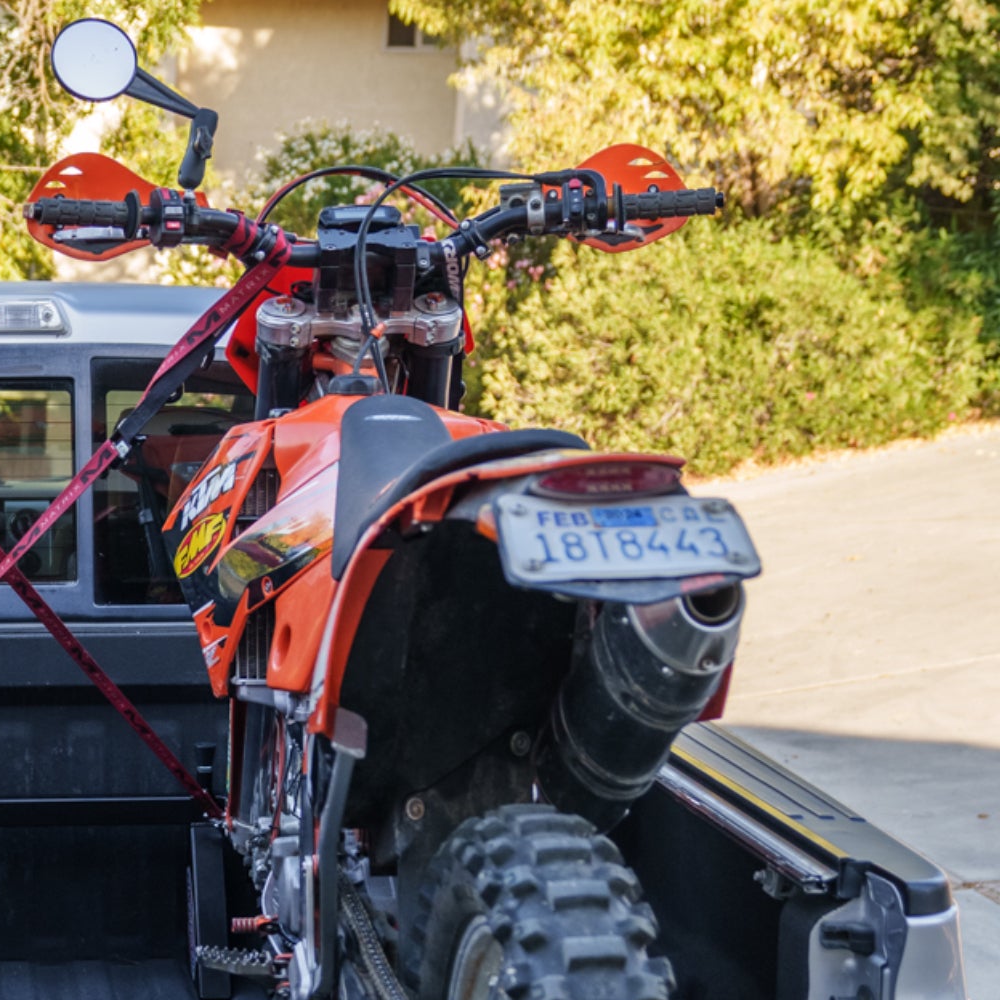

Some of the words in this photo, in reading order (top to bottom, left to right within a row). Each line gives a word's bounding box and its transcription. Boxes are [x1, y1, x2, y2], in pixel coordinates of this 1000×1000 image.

[218, 268, 272, 315] MATRIX
[180, 461, 237, 532] KTM
[536, 510, 590, 528] FEB
[658, 504, 726, 523] CAL
[176, 512, 223, 571] FMF
[535, 526, 730, 563] 18T8443
